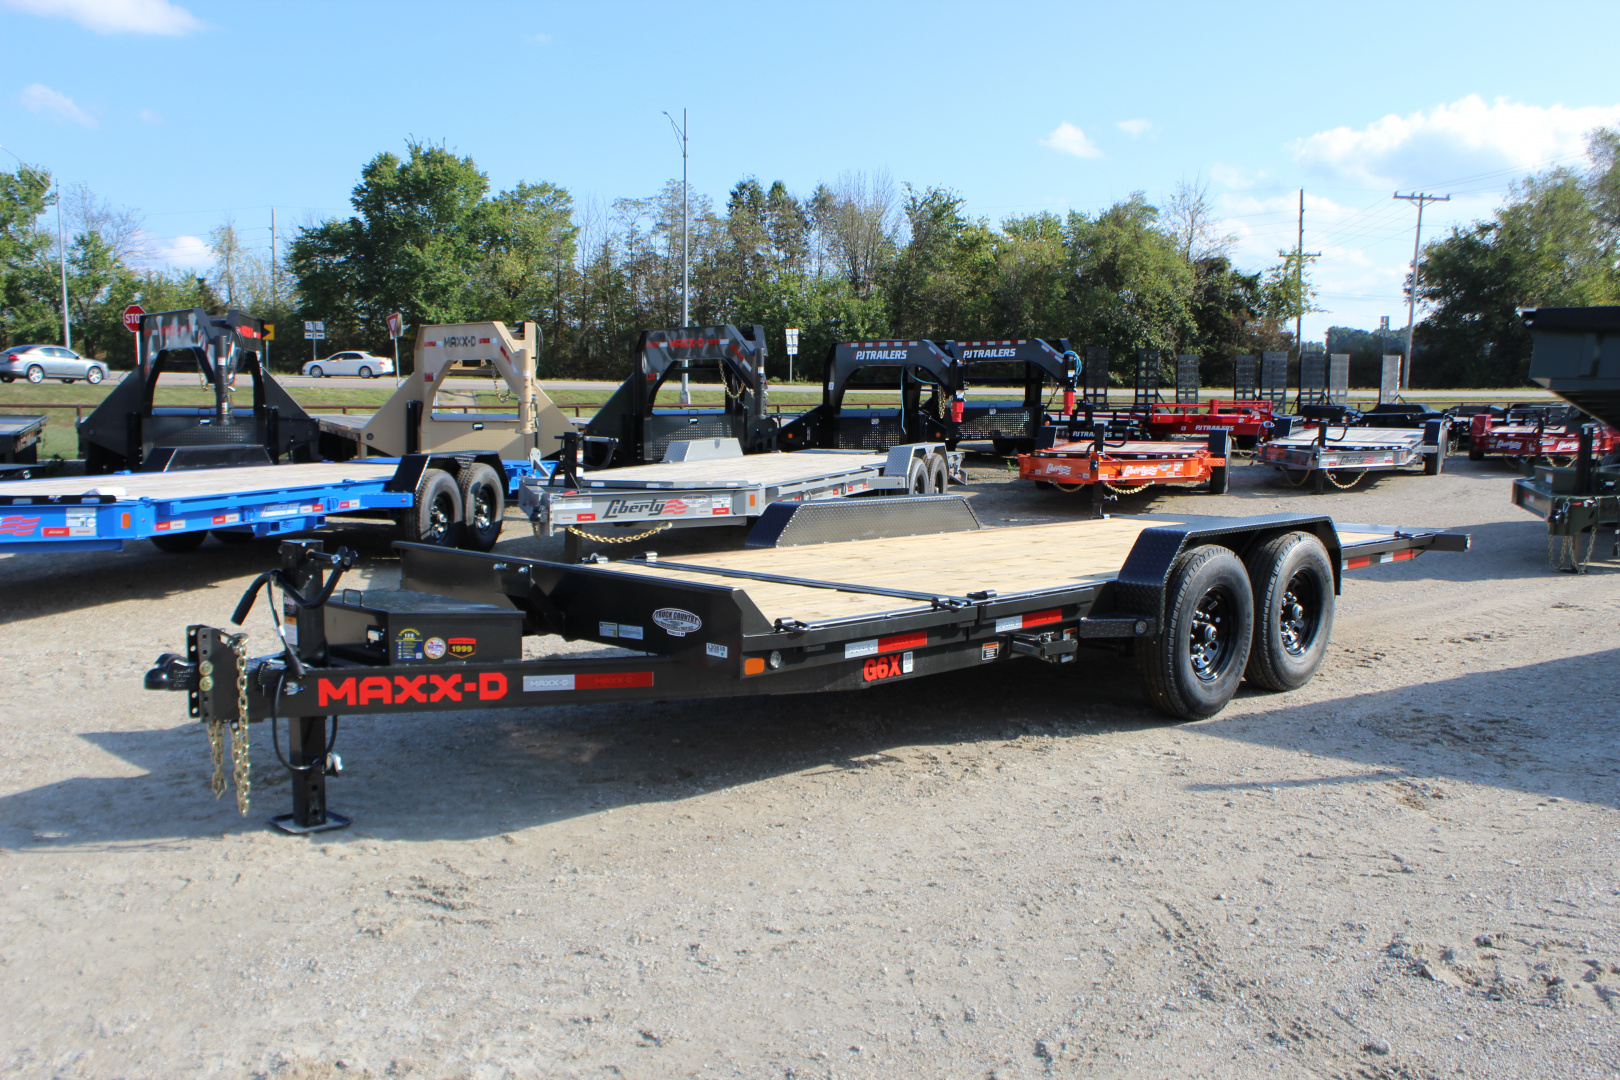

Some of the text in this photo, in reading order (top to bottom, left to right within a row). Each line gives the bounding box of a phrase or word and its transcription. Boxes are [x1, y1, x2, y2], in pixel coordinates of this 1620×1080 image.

[126, 314, 140, 324] STO
[444, 336, 476, 348] MAXX-D
[668, 338, 704, 348] MAXX-D
[856, 350, 907, 360] PJ TRAILERS
[963, 348, 1016, 358] PJ TRAILERS
[602, 499, 664, 518] Liberty
[655, 610, 673, 620] TRUCK
[863, 654, 902, 682] G6X
[530, 676, 633, 688] MAXX-D MAXX-D
[318, 672, 508, 706] MAXX-D
